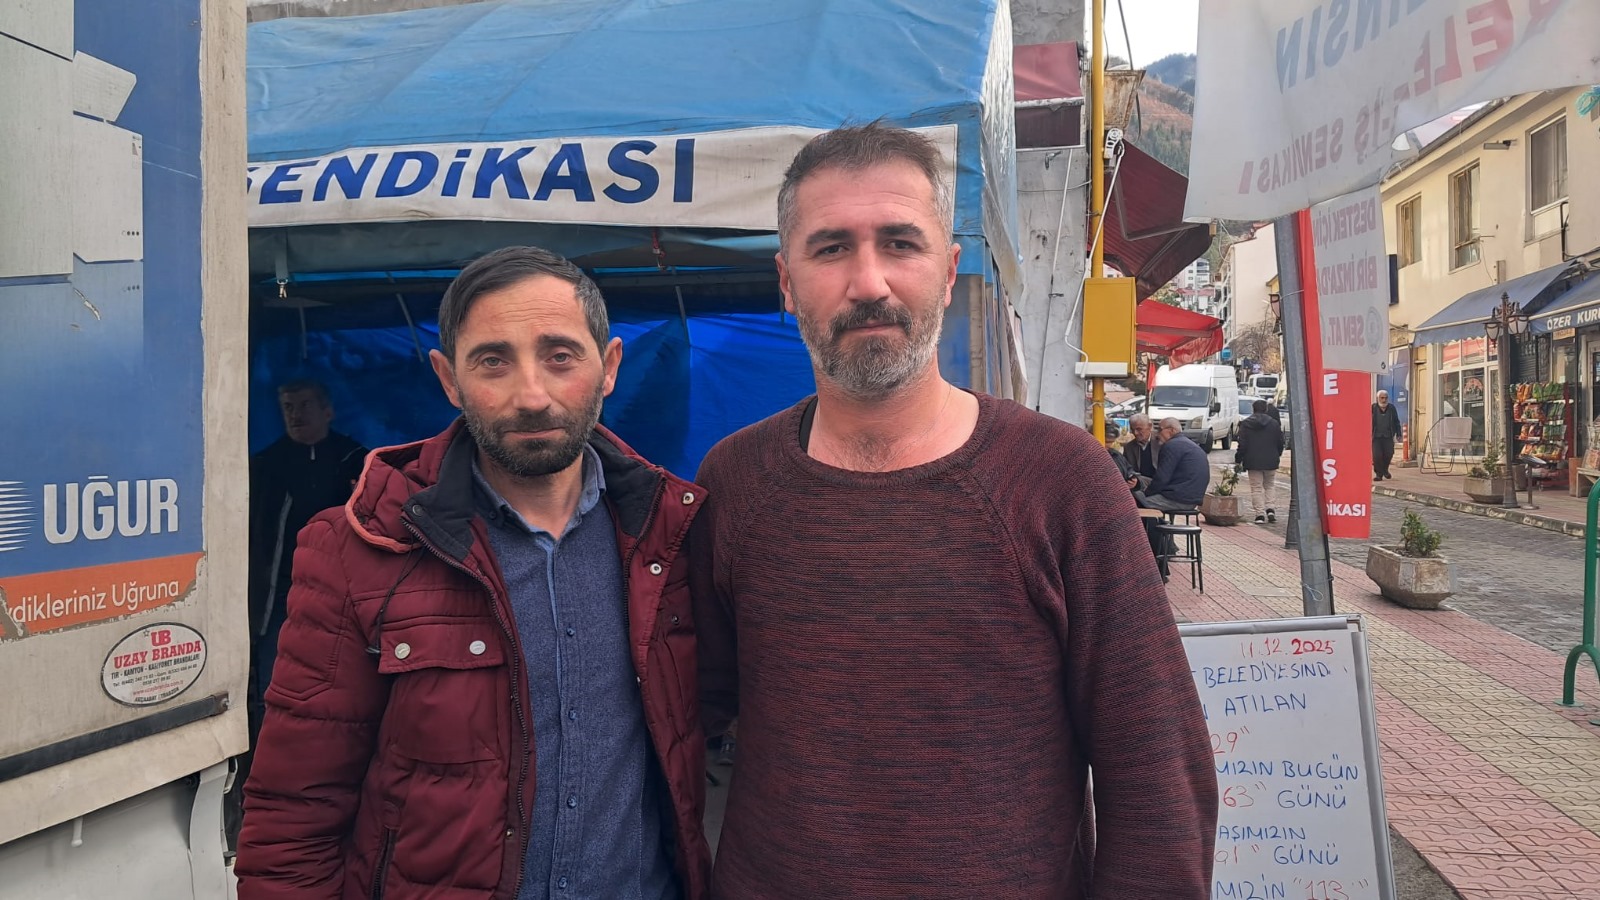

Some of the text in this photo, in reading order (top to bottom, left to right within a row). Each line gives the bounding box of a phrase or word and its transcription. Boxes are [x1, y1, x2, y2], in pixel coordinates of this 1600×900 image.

[43, 475, 179, 545] UĞUR
[112, 580, 179, 611] Uğruna
[114, 640, 202, 669] UZAY BRANDA
[124, 666, 144, 676] KAMYON
[1224, 693, 1307, 717] ATILAN
[1282, 753, 1359, 780] BUGÜN
[1277, 784, 1346, 809] GÜNÜ
[1274, 843, 1339, 865] GÜNÜ
